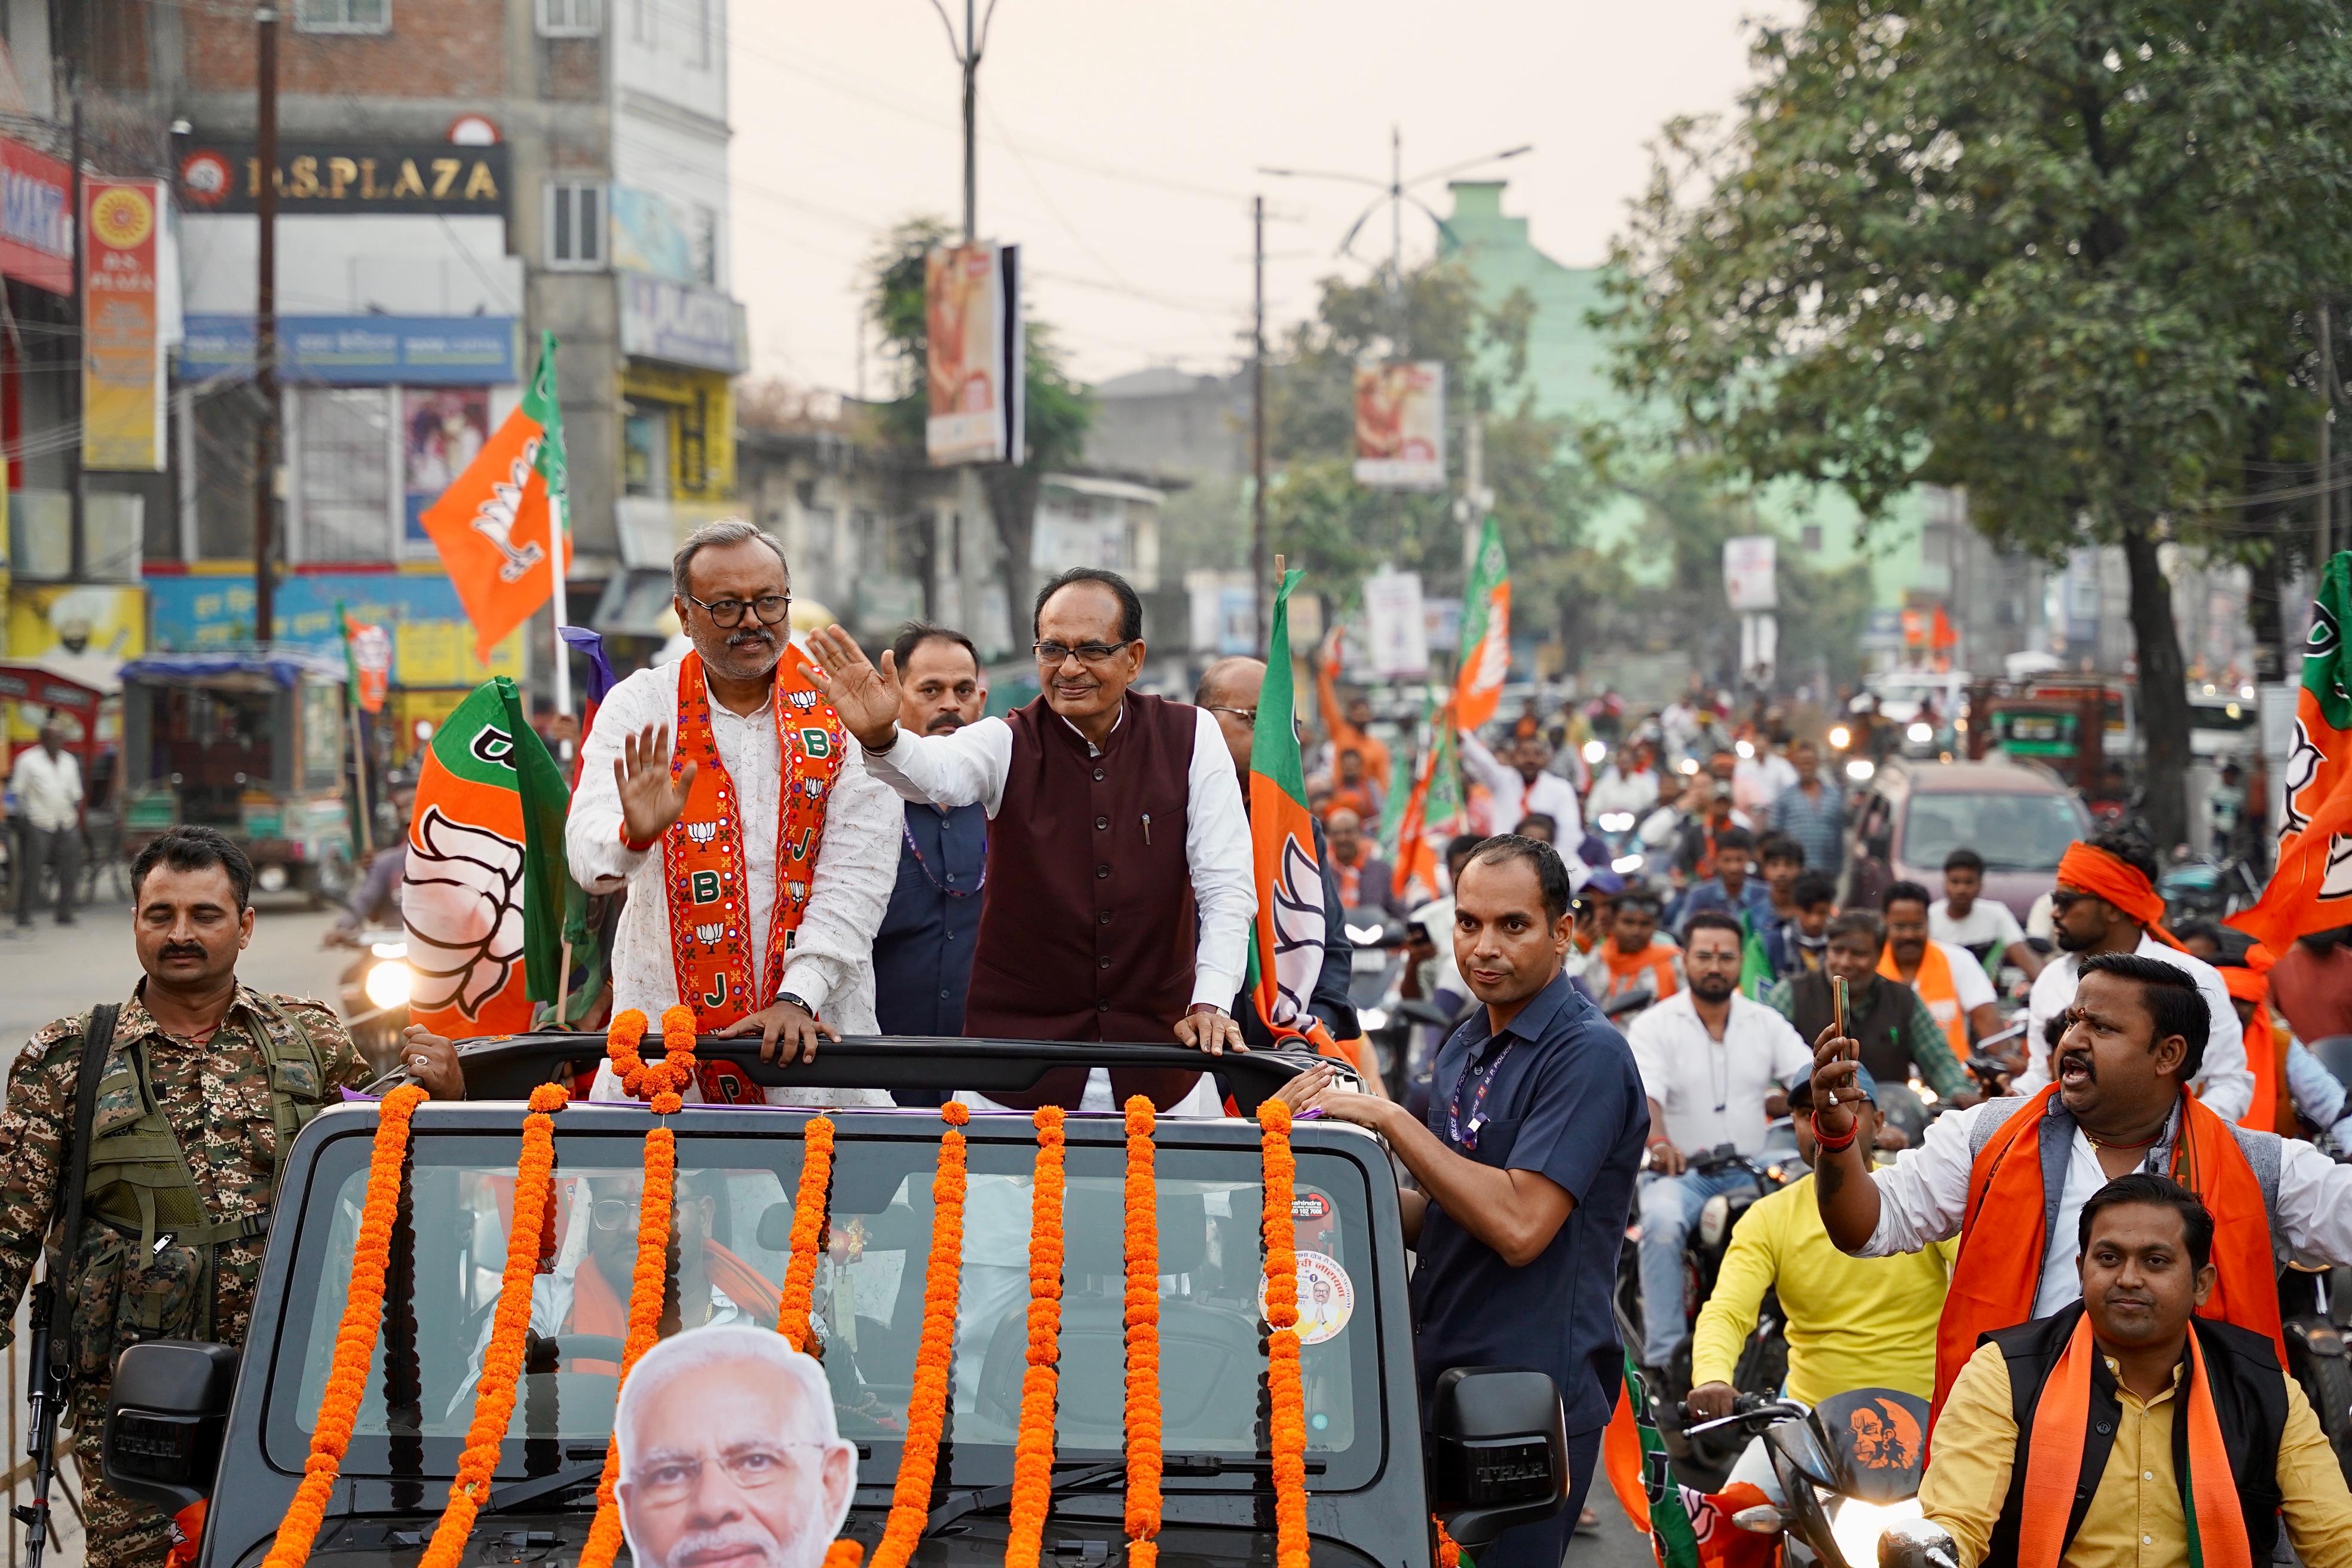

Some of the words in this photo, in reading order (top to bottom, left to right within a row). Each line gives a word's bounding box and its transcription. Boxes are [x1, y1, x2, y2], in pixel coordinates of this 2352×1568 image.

[801, 727, 831, 759] B
[792, 827, 812, 862] J
[691, 870, 721, 905] B
[703, 972, 728, 1009] J
[1484, 1076, 1493, 1085] M.
[1490, 1068, 1497, 1077] P.
[1494, 1043, 1514, 1069] POLICE
[116, 1434, 182, 1459] THAR
[1476, 1462, 1549, 1483] THAR
